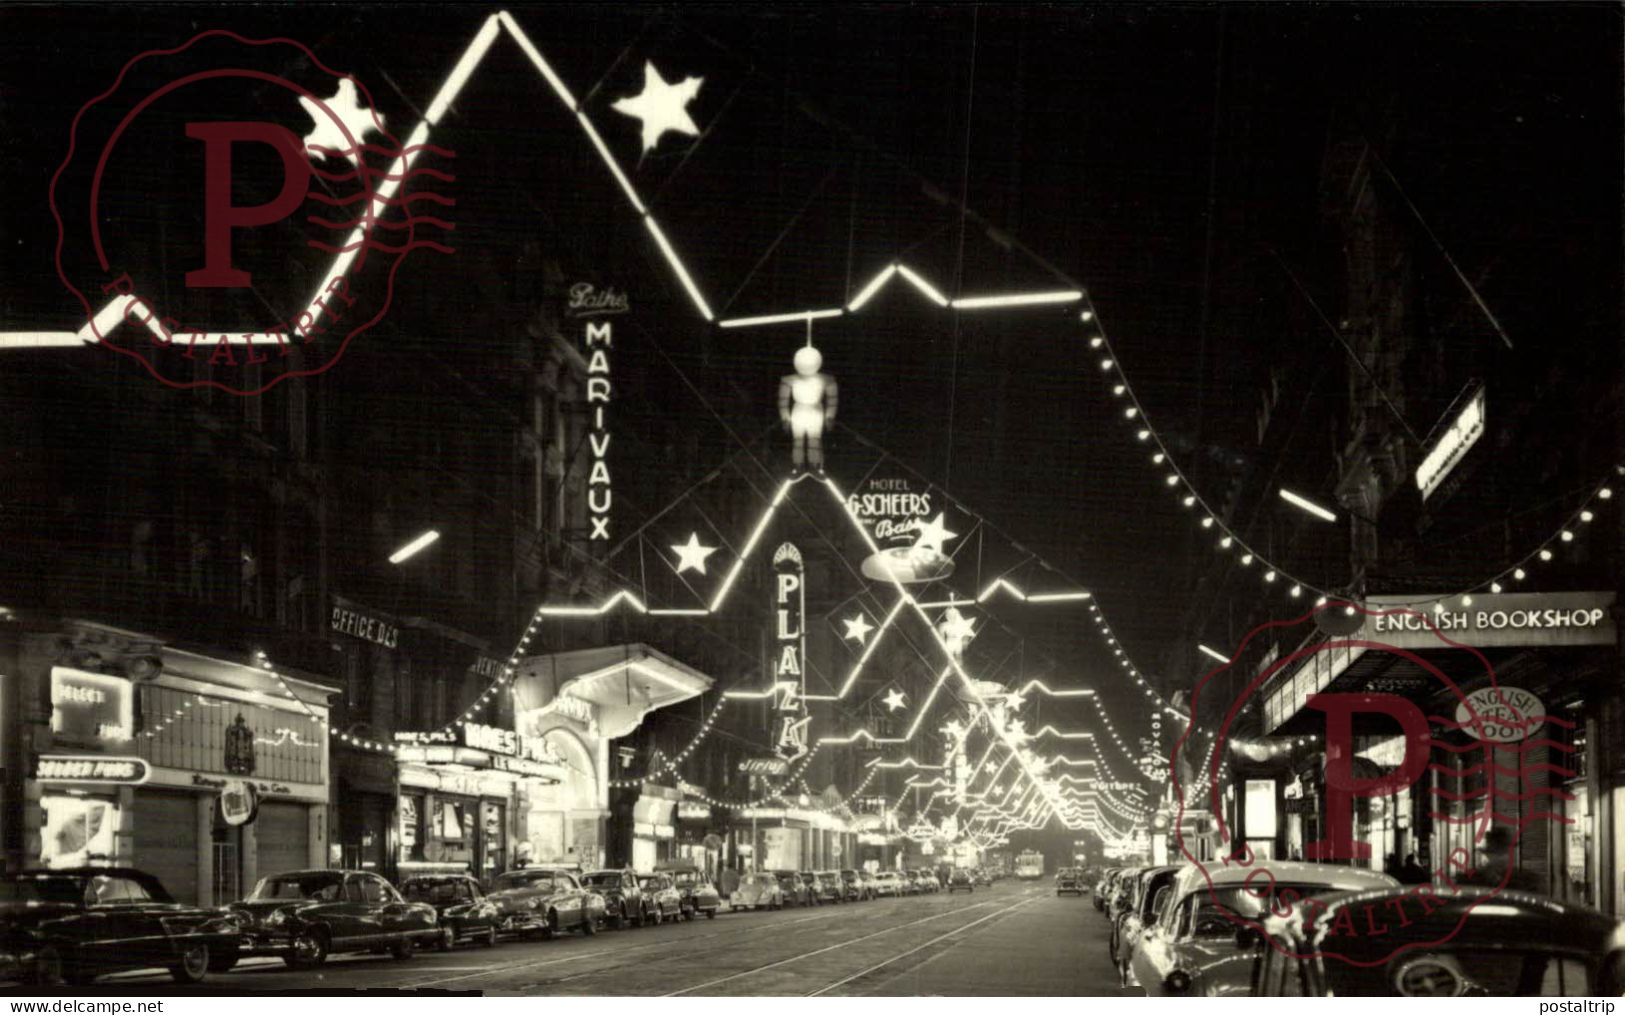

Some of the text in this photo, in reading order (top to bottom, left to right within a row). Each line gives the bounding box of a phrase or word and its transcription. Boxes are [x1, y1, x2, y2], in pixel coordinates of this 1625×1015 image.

[586, 322, 612, 540] MARIVAUX
[869, 479, 911, 491] HOTEL
[331, 607, 375, 639] OFFICE
[1375, 608, 1603, 631] ENGLISH BOOKSHOP
[777, 574, 801, 747] PLAZA
[1463, 689, 1537, 713] ENGLISH
[1481, 706, 1520, 724] TEA
